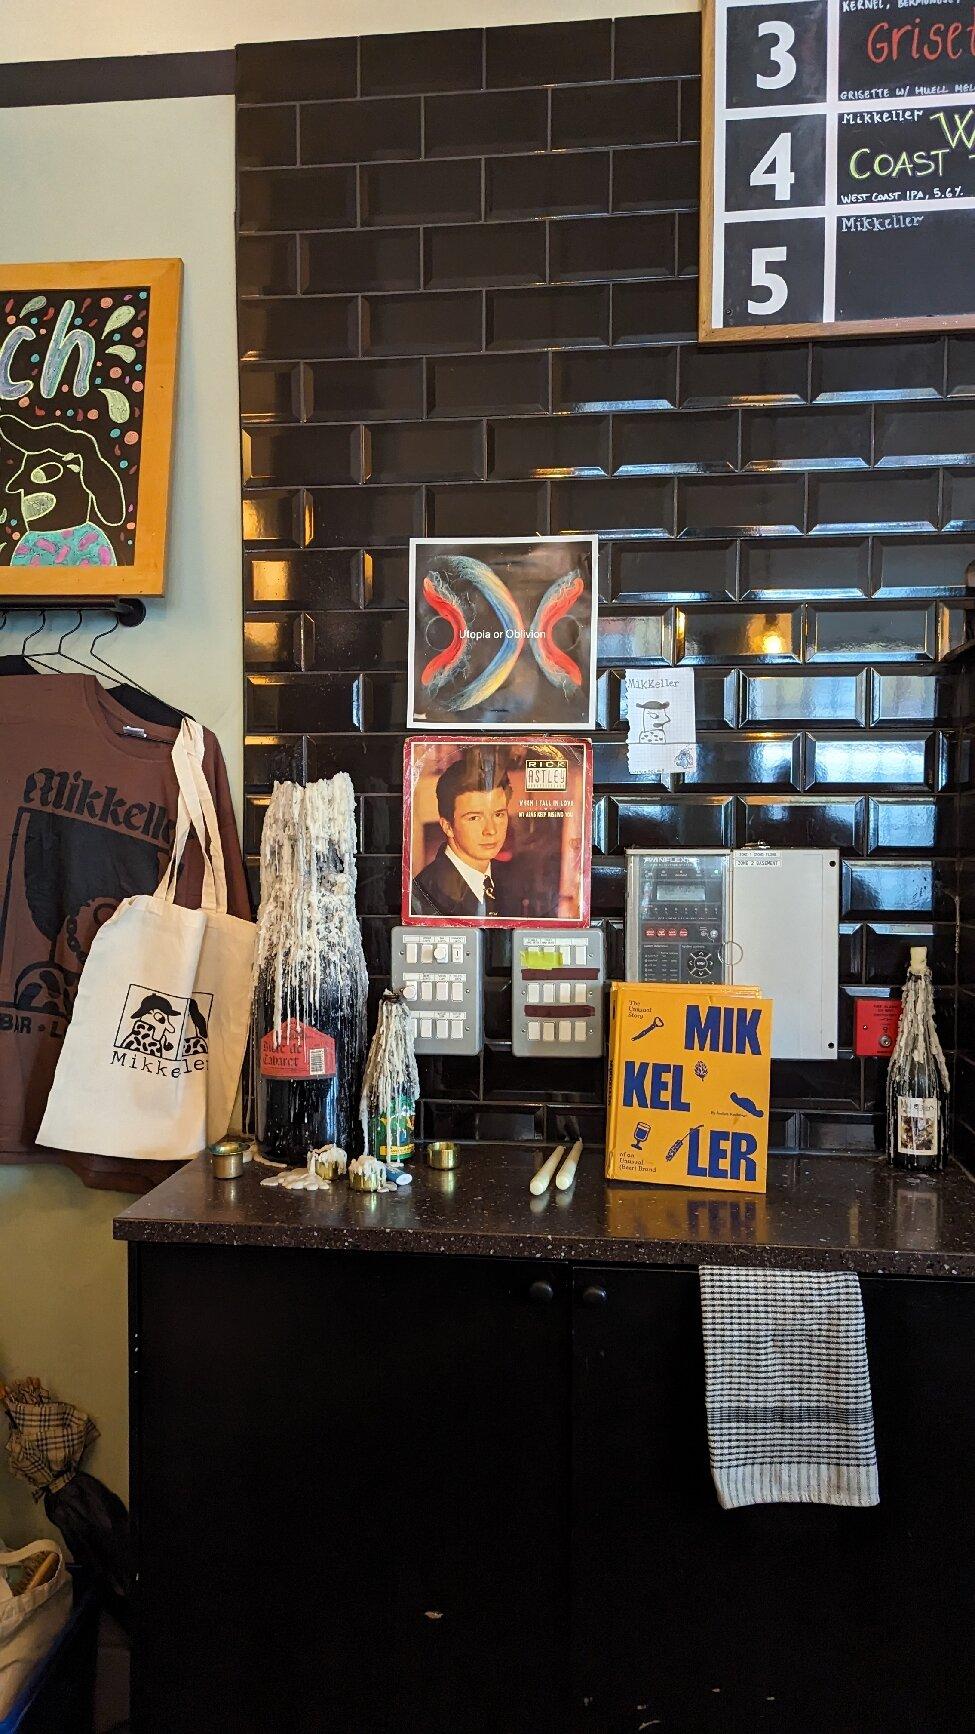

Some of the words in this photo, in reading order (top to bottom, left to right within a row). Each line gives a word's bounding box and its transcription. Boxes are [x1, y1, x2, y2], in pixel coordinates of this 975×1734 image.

[756, 21, 797, 89] 3
[840, 88, 889, 100] GRISETTE
[750, 133, 794, 200] 4
[849, 148, 950, 179] COAST
[841, 193, 870, 204] WEST
[872, 191, 901, 201] COAST
[748, 246, 788, 315] 5
[460, 629, 491, 641] Utopia
[493, 631, 504, 639] or
[505, 628, 546, 639] Oblivion
[684, 1005, 762, 1056] MIK
[622, 1061, 690, 1112] KEL
[687, 1128, 758, 1182] LER
